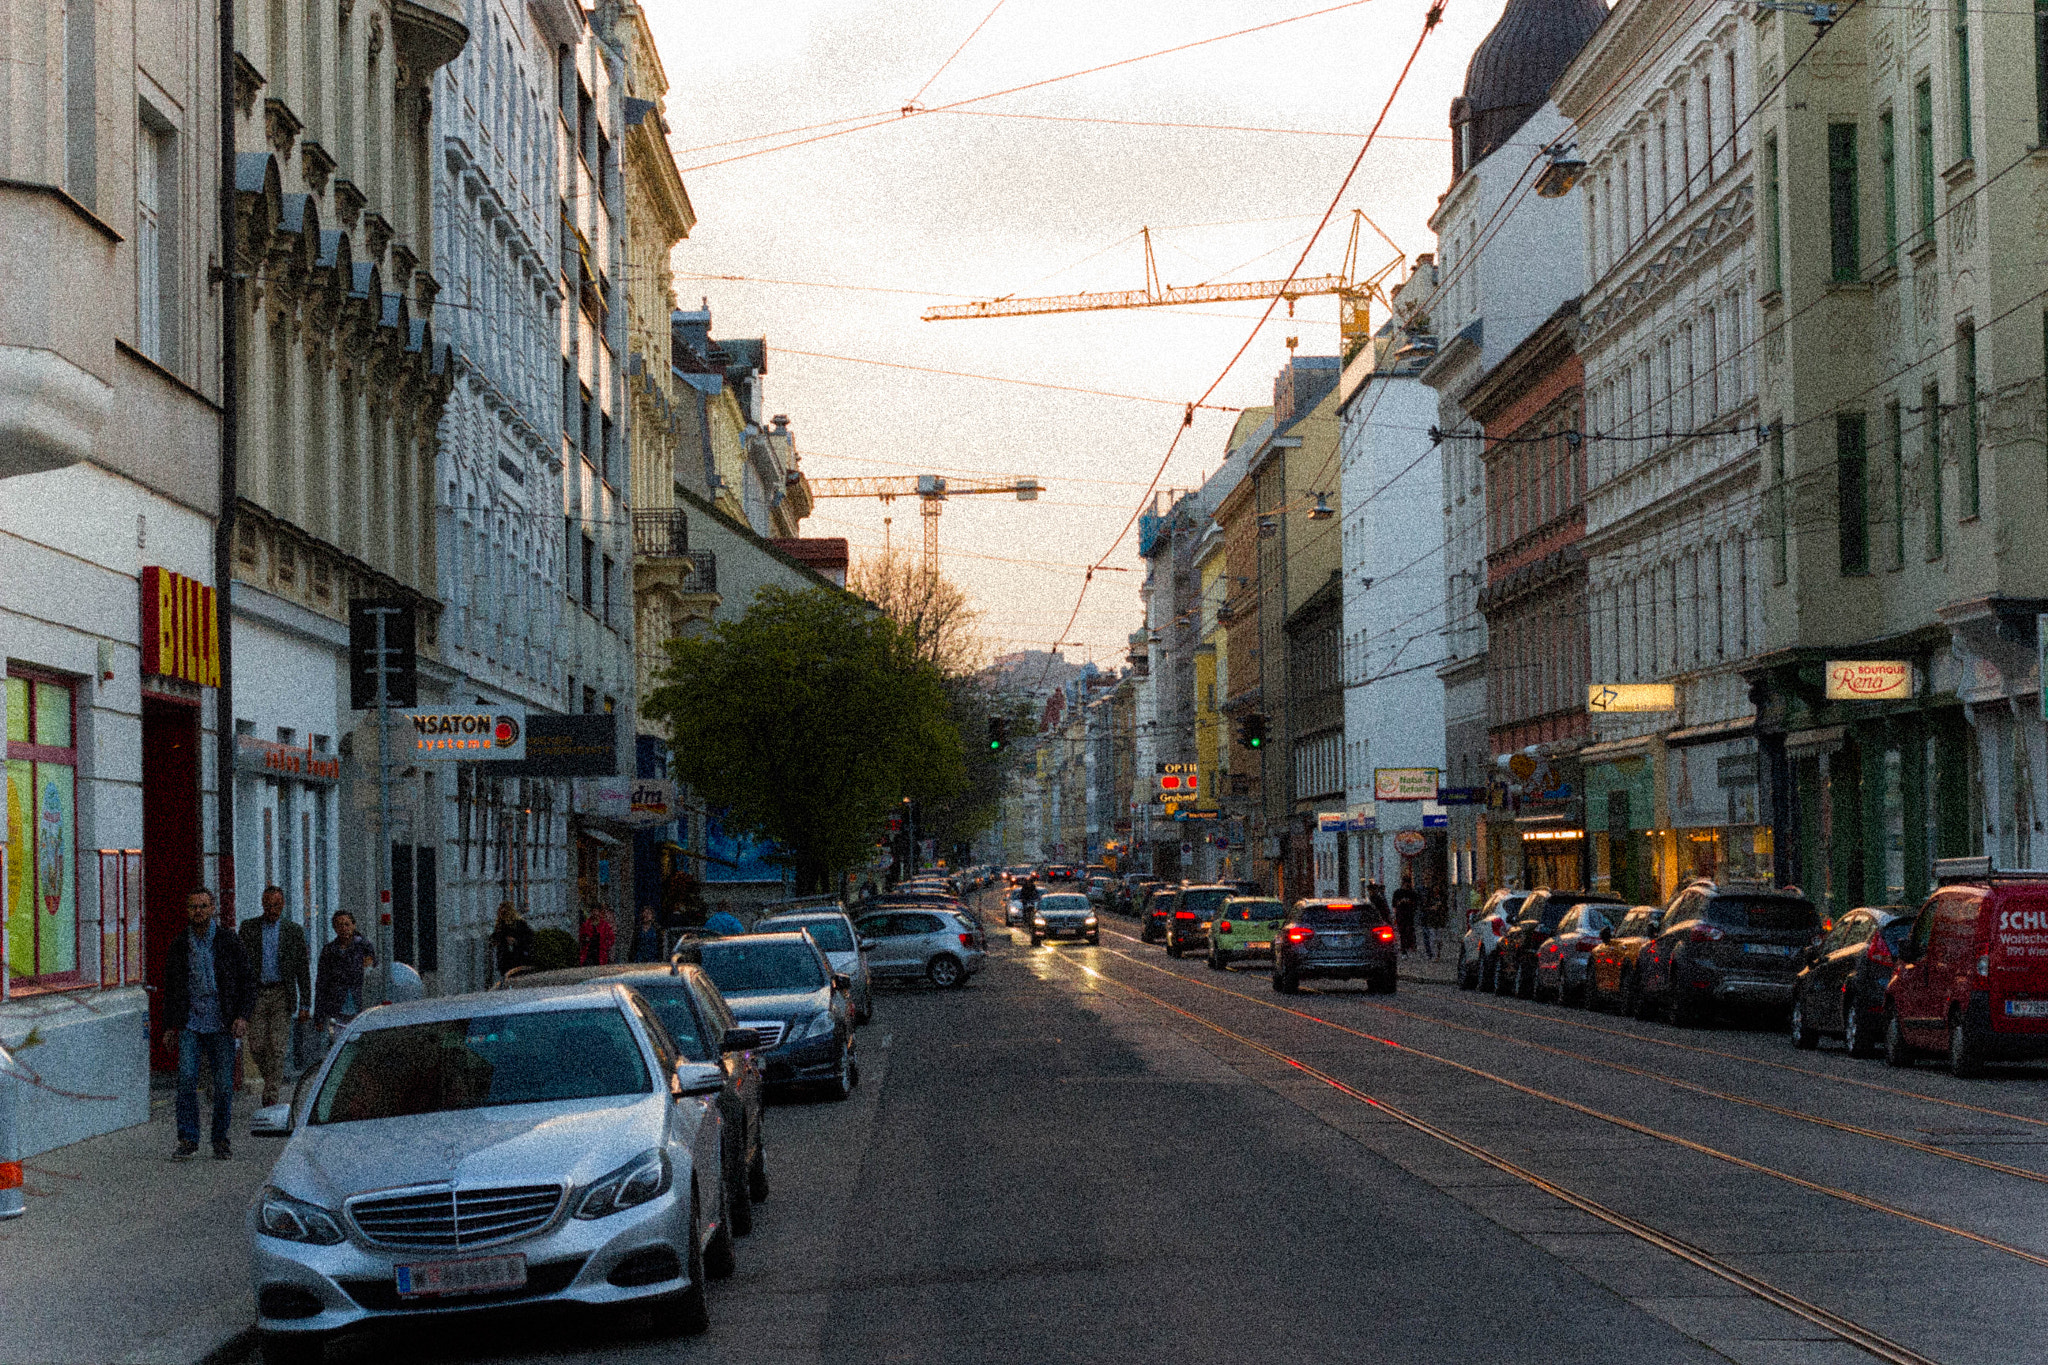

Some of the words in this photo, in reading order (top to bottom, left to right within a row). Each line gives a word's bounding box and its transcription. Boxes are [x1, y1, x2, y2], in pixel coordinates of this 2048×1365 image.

[158, 566, 221, 688] BILLA
[1833, 667, 1886, 692] Rena
[1858, 665, 1905, 675] BOUTIQUE
[410, 714, 491, 735] NSATON
[631, 785, 662, 804] dm
